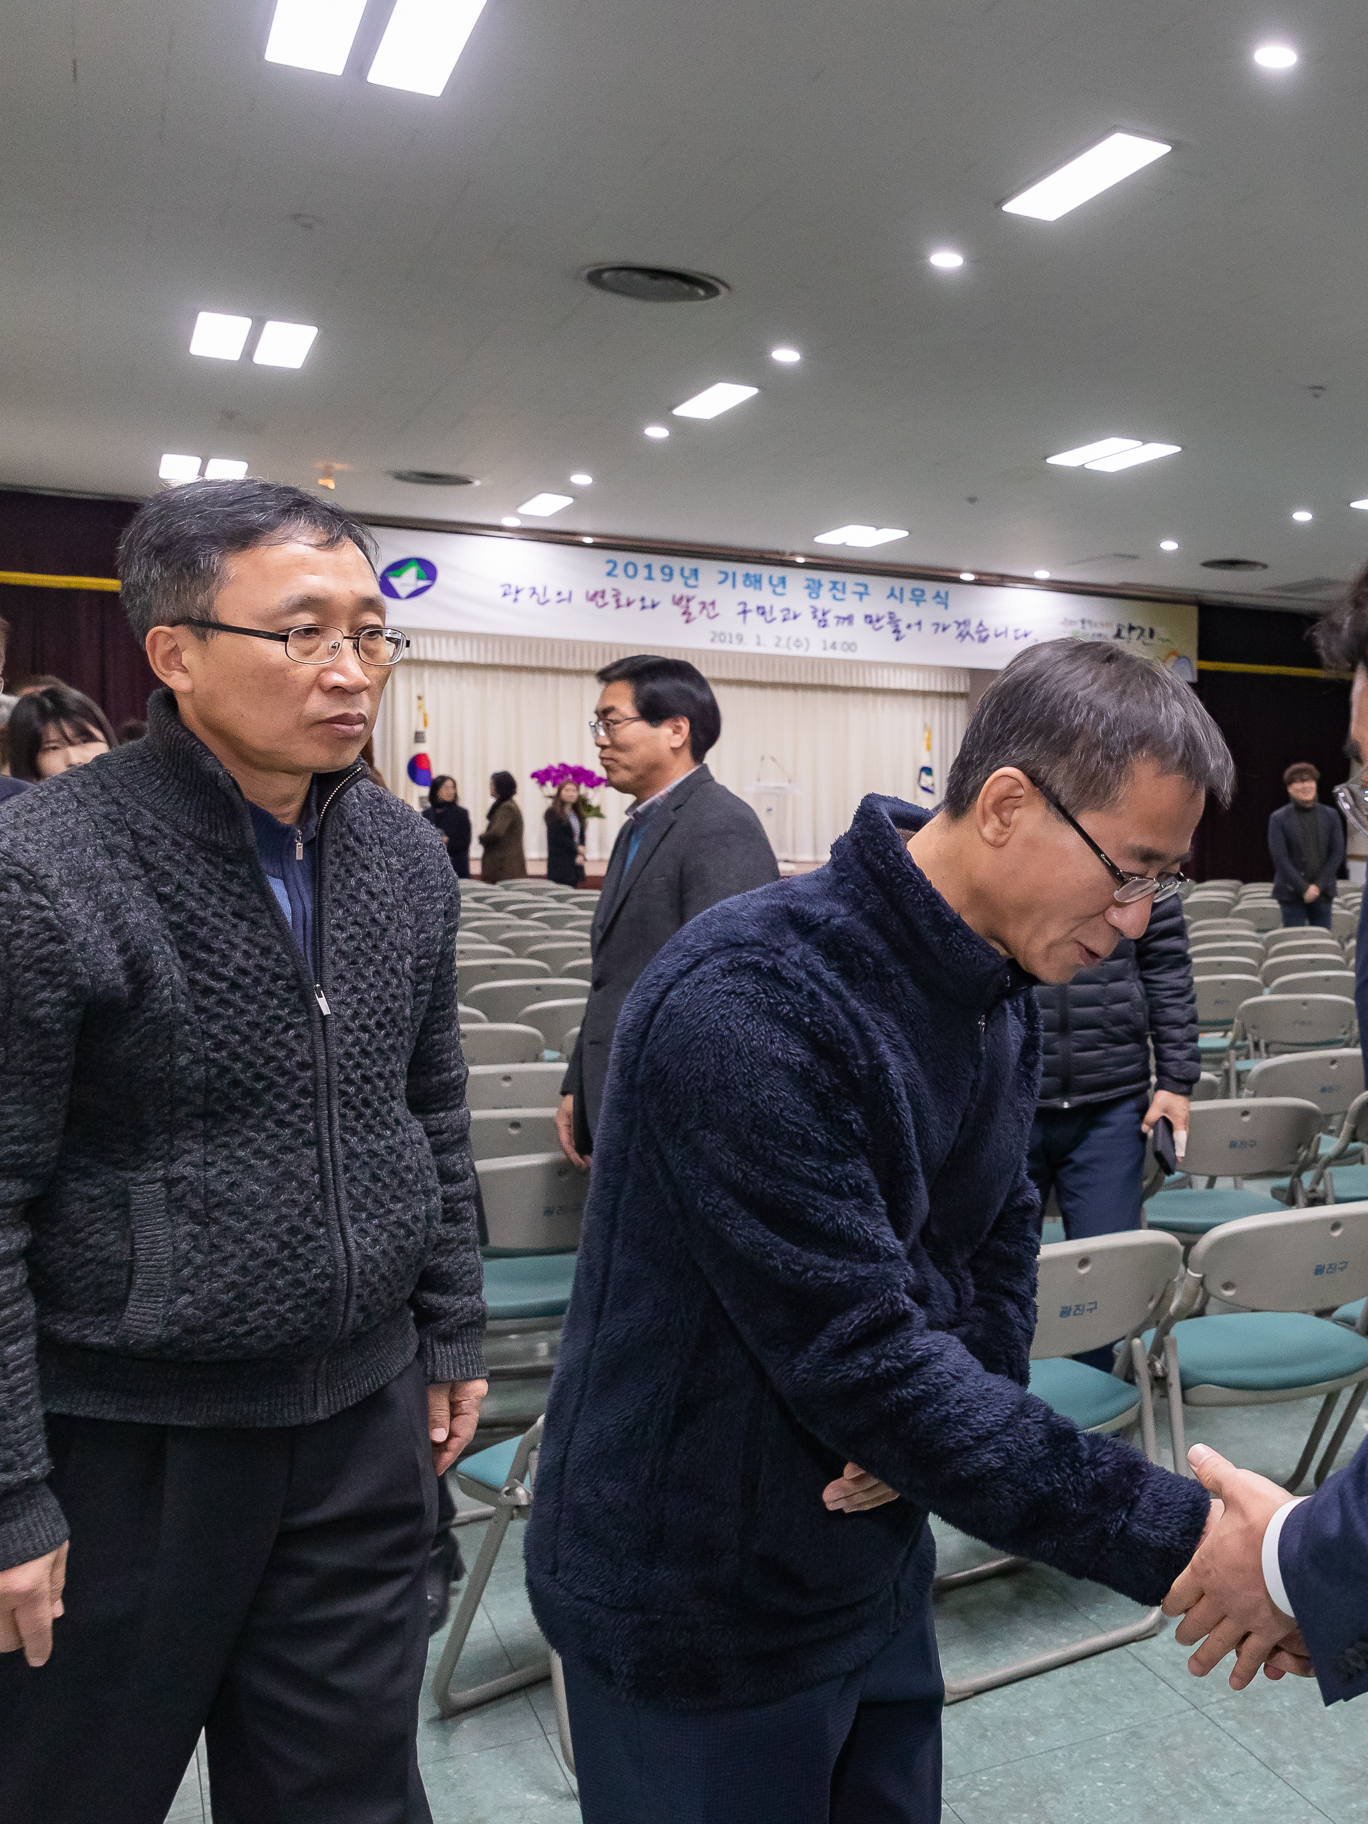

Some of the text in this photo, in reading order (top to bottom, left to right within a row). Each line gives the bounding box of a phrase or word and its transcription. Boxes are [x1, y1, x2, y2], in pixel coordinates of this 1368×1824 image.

[604, 559, 950, 610] 2019년 기해년 광진구 시무식
[500, 583, 573, 605] 광진의
[585, 587, 661, 612] 변화와
[672, 593, 720, 624] 발전
[736, 600, 802, 624] 구민과
[809, 604, 855, 628] 함께
[863, 610, 923, 642] 만들어
